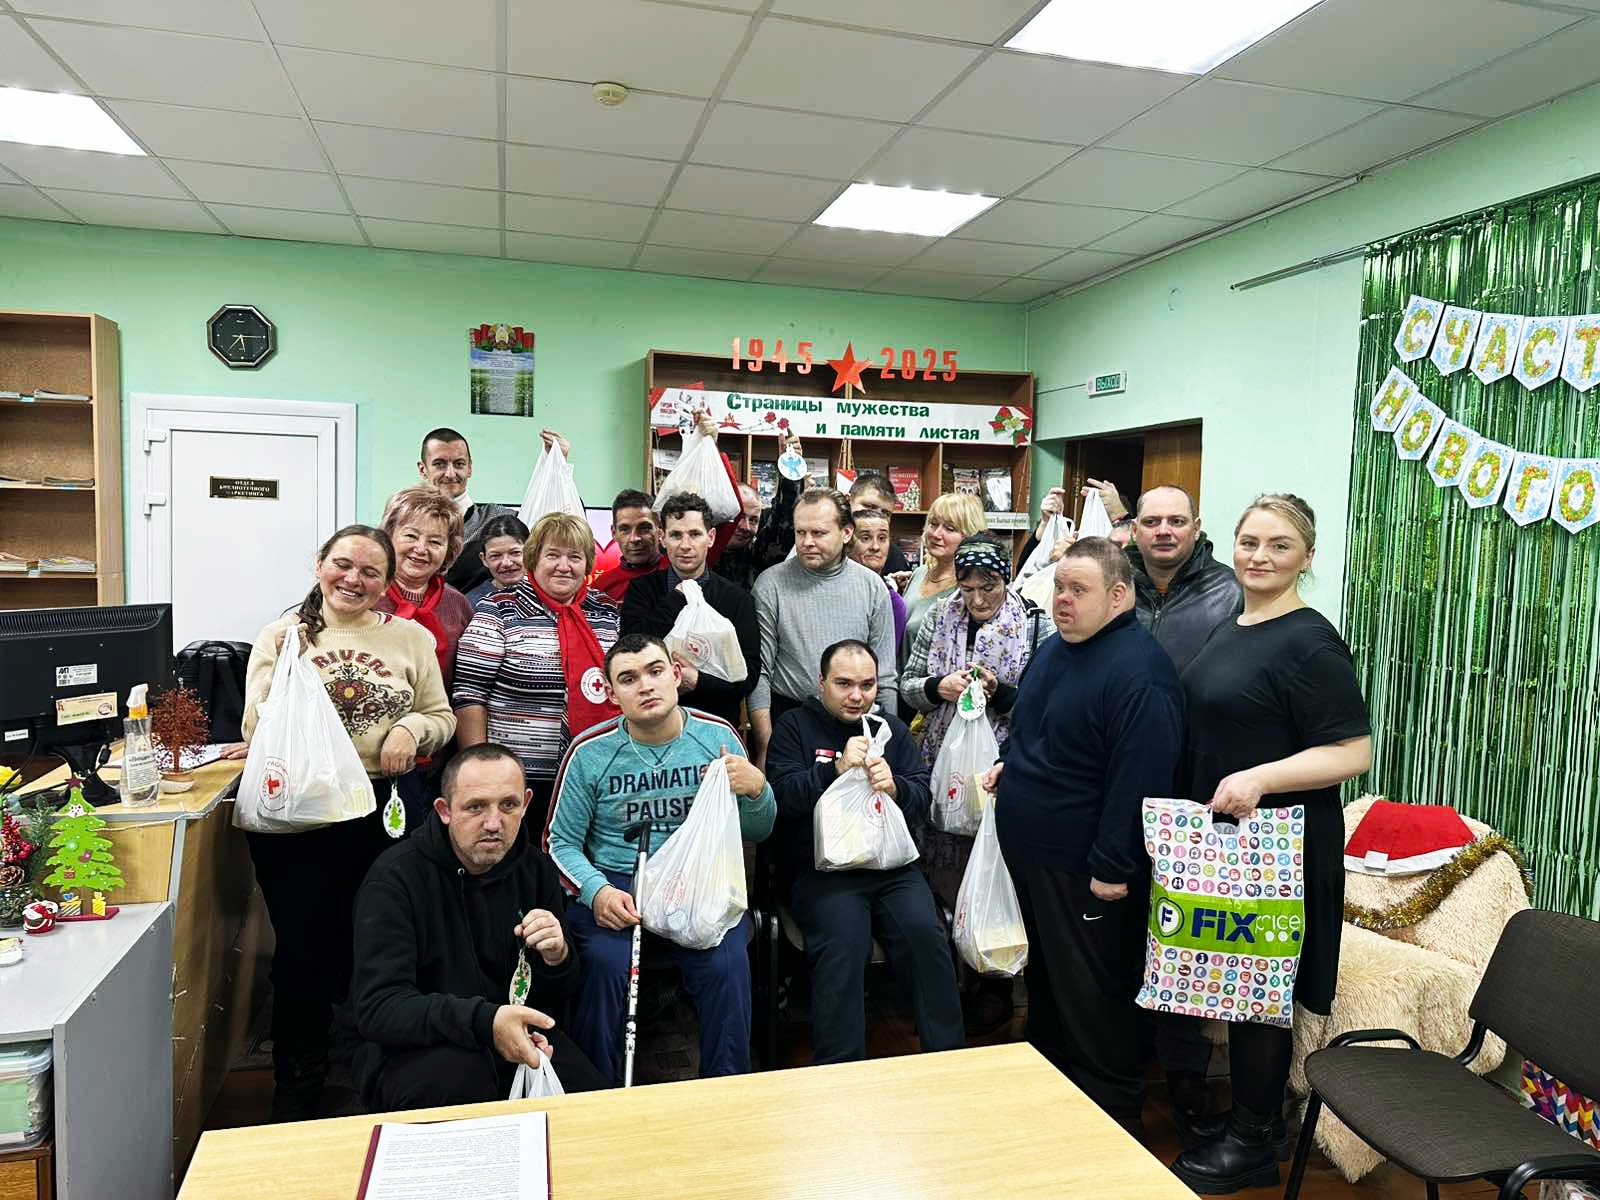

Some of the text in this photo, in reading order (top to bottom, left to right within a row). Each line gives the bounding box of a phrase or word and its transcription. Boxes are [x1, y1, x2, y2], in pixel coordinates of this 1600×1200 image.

[731, 336, 814, 375] 1945
[1403, 308, 1600, 380] СЧАСТ
[880, 347, 960, 382] 2025
[1096, 374, 1121, 391] ВЫХОД
[726, 393, 930, 418] Страницы мужества
[815, 423, 980, 441] и памяти листая
[1373, 379, 1596, 522] НОВОГО
